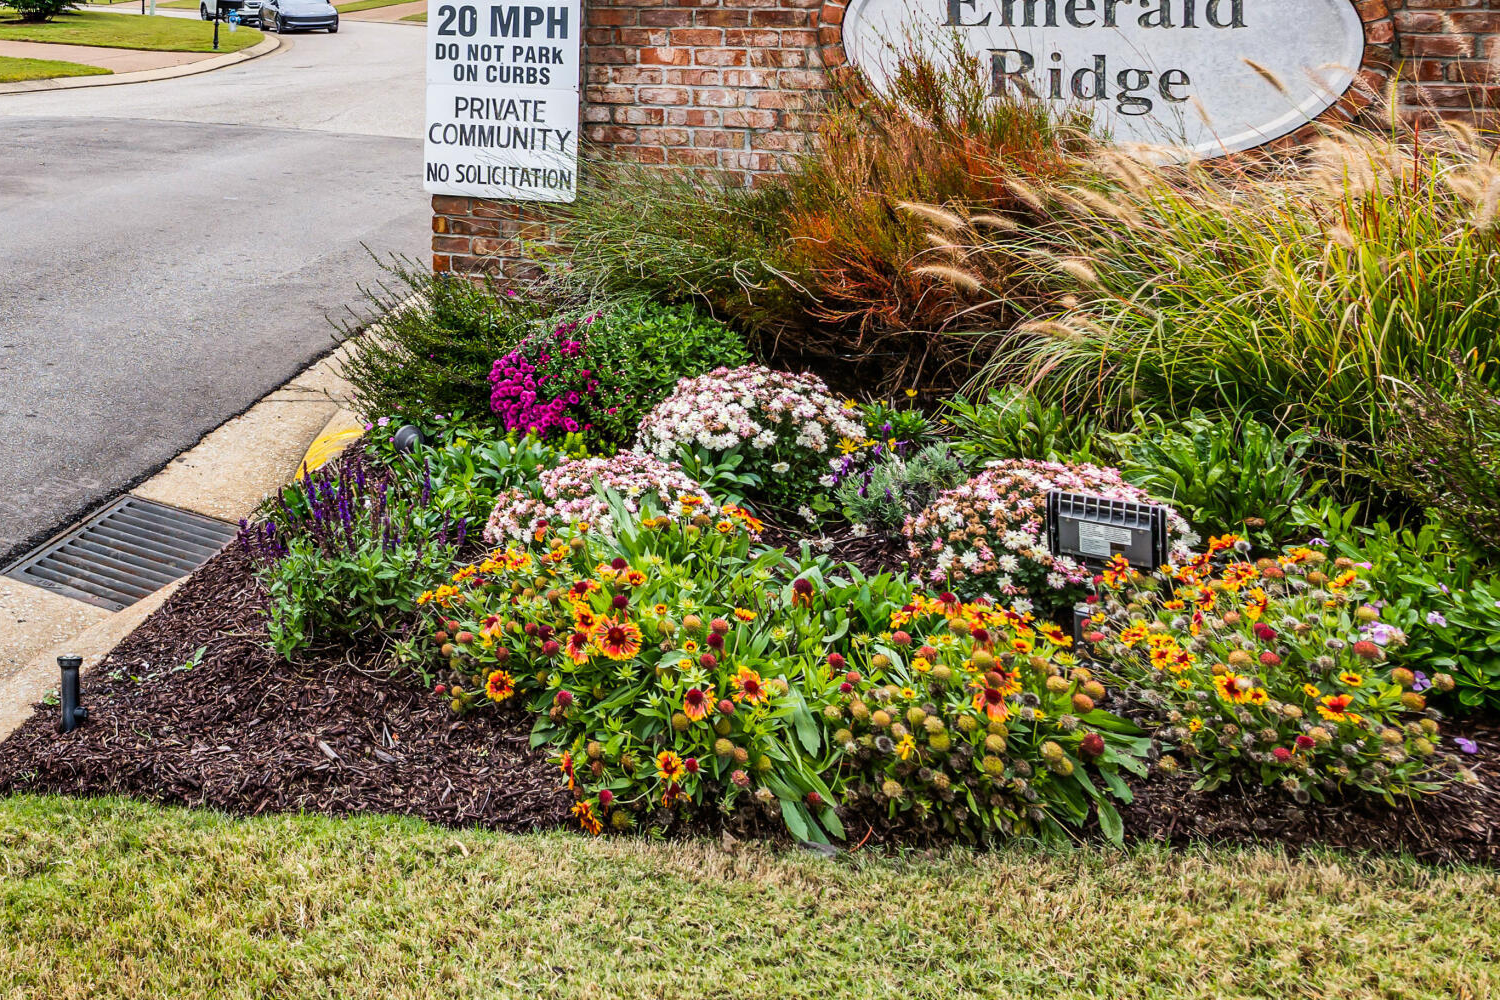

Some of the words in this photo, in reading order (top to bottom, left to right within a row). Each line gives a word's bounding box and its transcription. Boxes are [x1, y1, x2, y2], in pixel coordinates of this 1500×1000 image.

[437, 4, 478, 38] 20
[490, 5, 569, 40] MPH
[435, 42, 460, 62] DO
[467, 44, 504, 62] NOT
[512, 45, 564, 65] PARK
[453, 64, 478, 82] ON
[486, 65, 551, 85] CURBS
[986, 47, 1192, 117] Ridge
[454, 96, 547, 123] PRIVATE
[428, 122, 572, 152] COMMUNITY
[426, 162, 450, 184] NO
[455, 163, 572, 192] SOLICITATION
